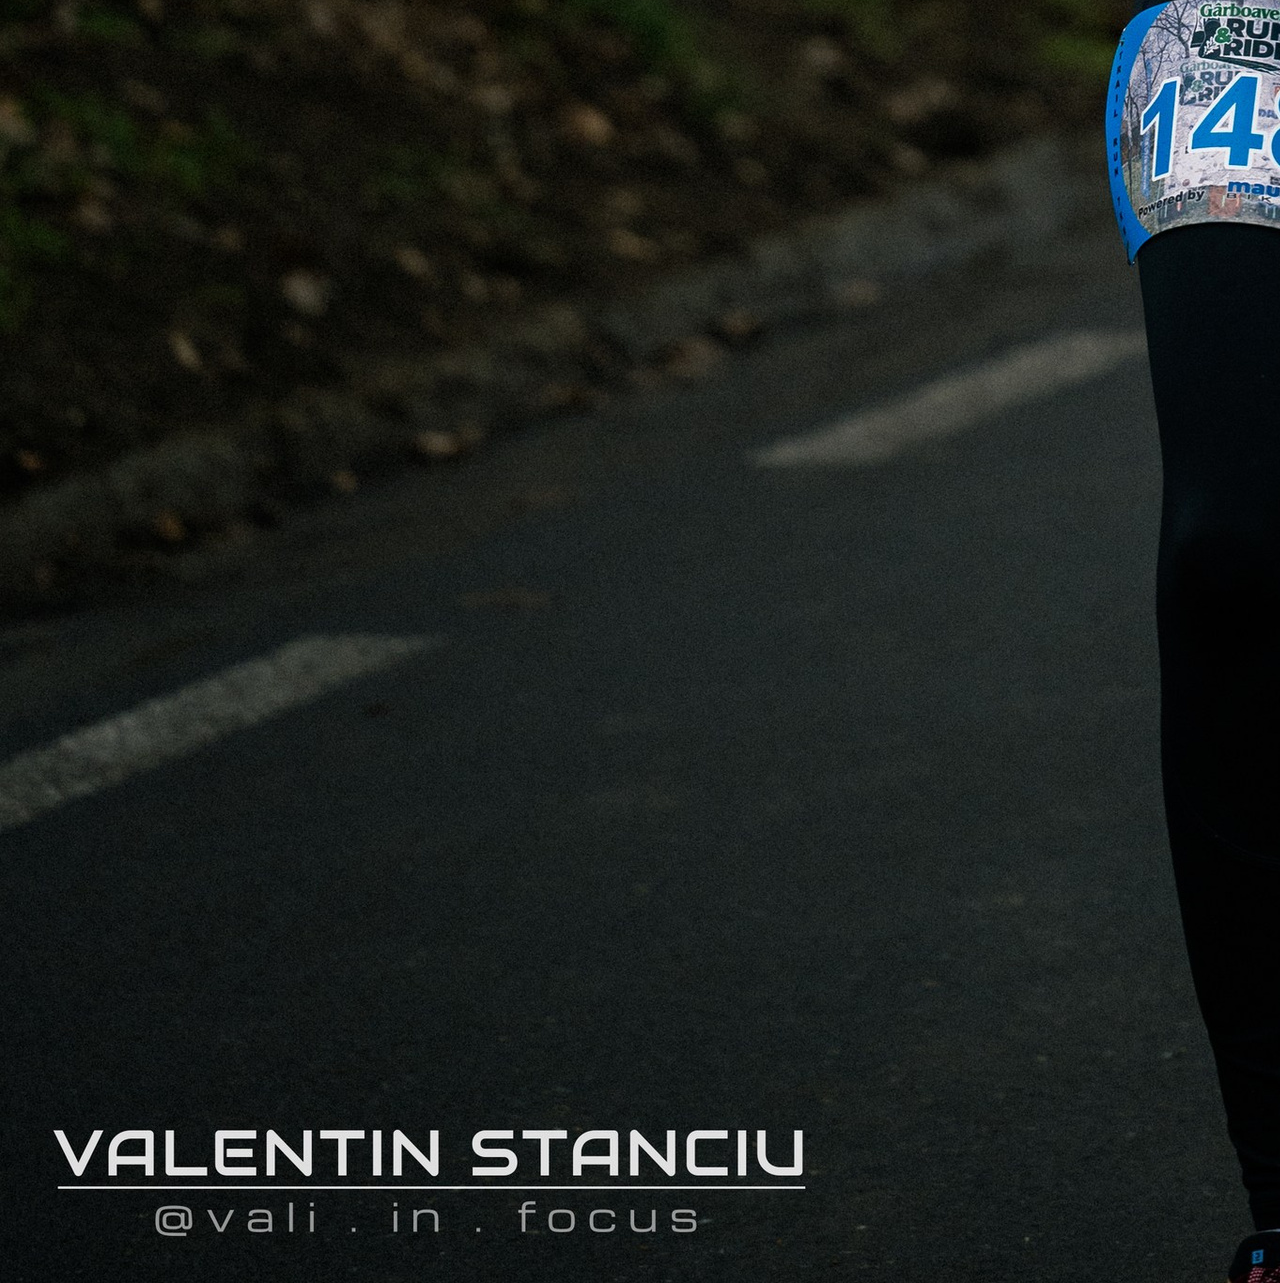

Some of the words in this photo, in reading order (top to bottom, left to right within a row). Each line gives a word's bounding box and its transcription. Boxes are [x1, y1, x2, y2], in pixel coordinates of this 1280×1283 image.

[1214, 27, 1232, 43] &
[1138, 192, 1183, 218] Powered
[1187, 189, 1205, 201] by
